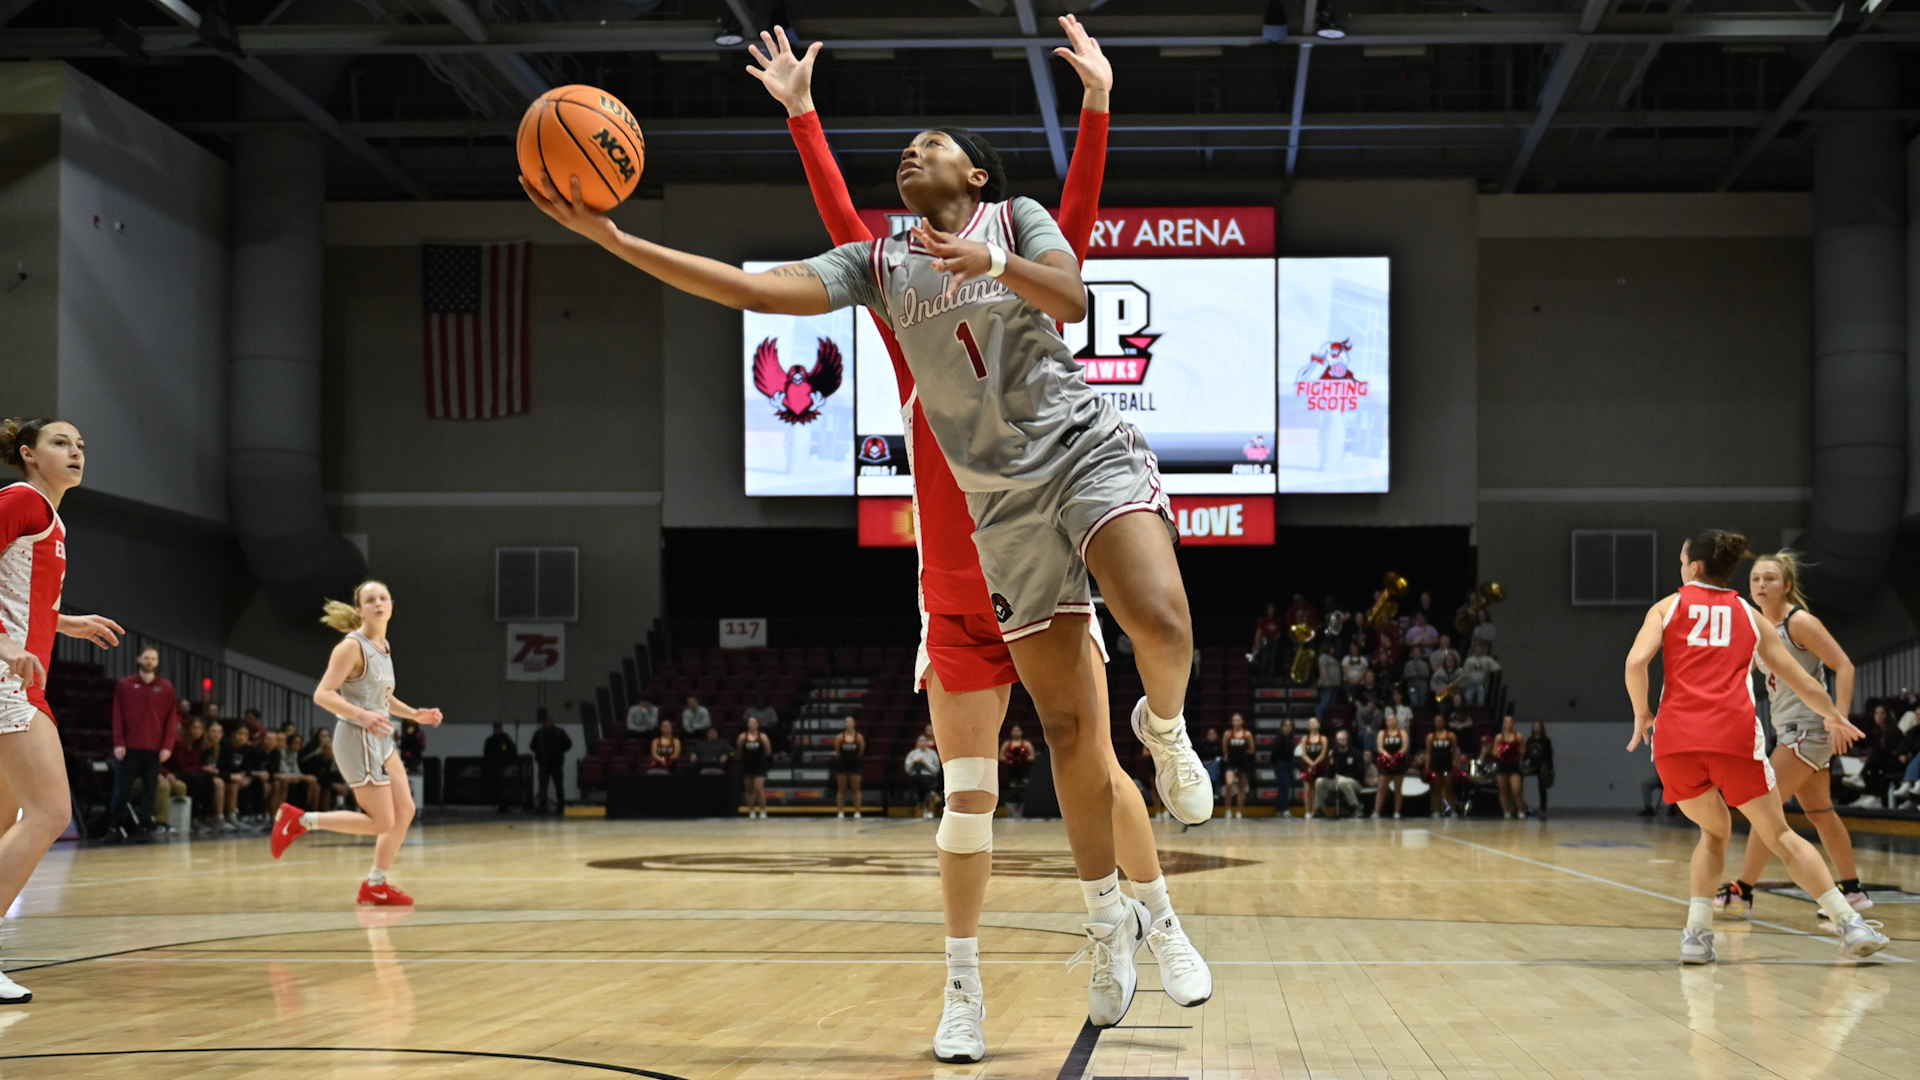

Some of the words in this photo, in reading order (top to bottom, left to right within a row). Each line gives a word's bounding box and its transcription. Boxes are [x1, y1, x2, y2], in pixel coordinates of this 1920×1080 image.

[592, 127, 636, 183] NCAA
[1090, 219, 1125, 247] RY
[1132, 218, 1246, 246] ARENA
[955, 318, 989, 380] 1
[1084, 360, 1138, 379] AWKS
[1297, 381, 1369, 396] FIGHTING
[1307, 396, 1359, 413] SCOTS
[1178, 503, 1244, 537] LOVE
[725, 622, 760, 639] 117
[1687, 604, 1732, 647] 20
[512, 633, 559, 668] 75
